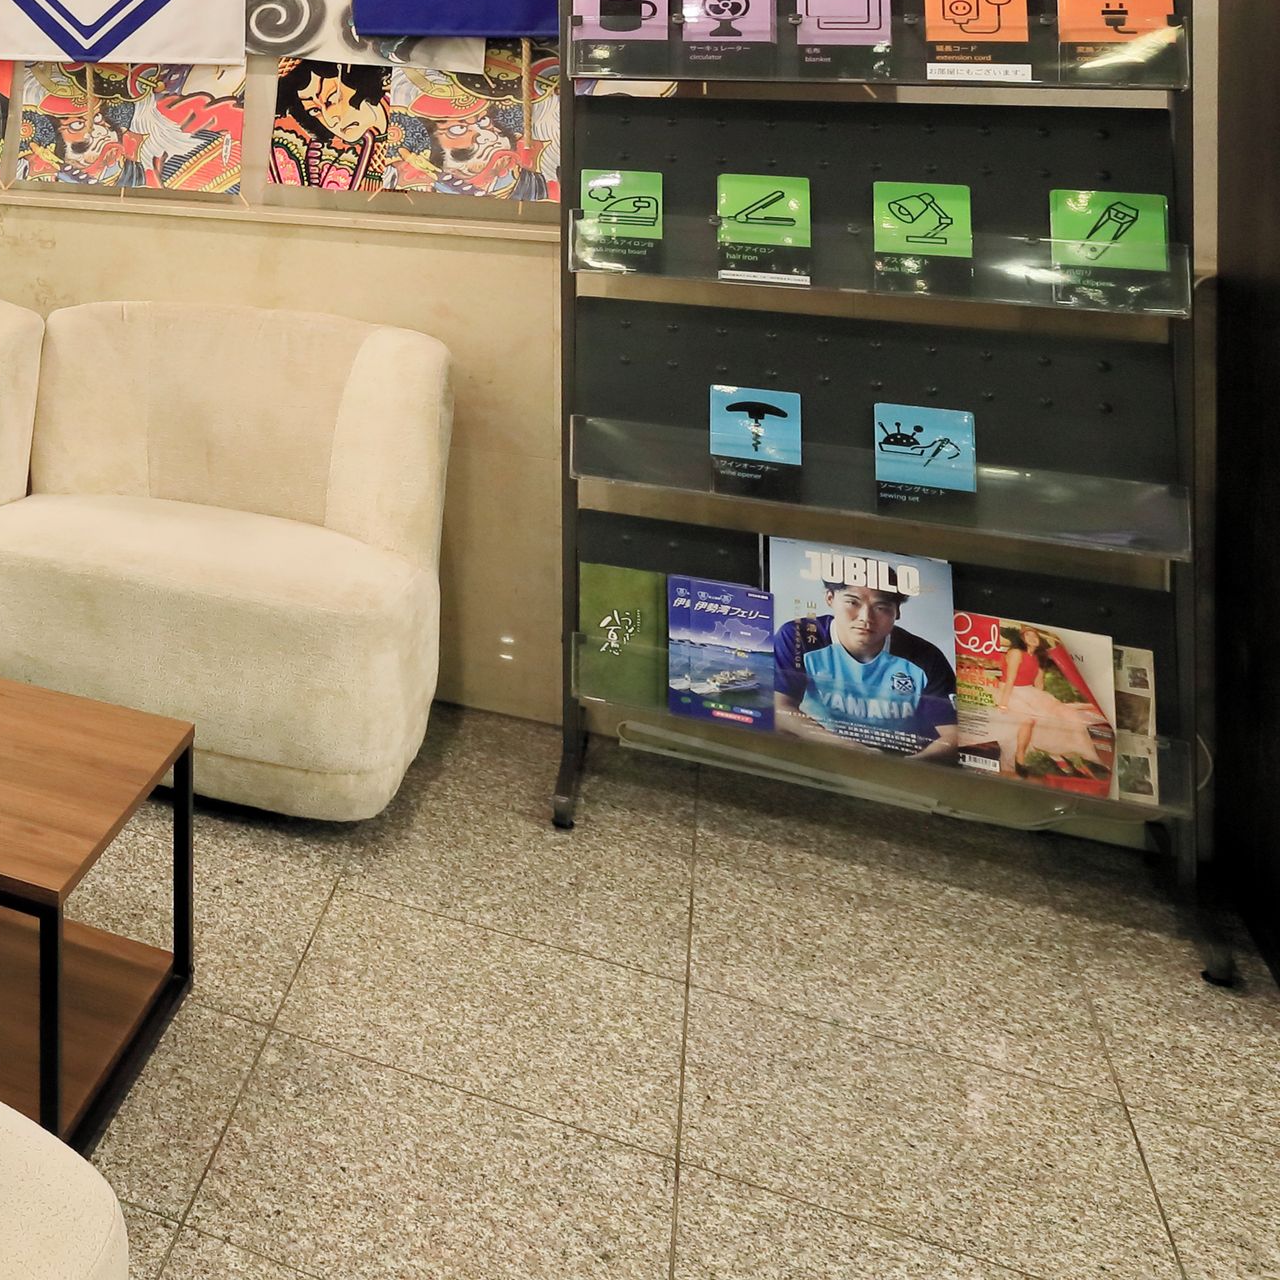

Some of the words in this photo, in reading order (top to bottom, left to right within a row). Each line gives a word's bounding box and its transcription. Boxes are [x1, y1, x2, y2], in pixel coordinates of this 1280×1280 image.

[690, 53, 722, 61] circulator
[726, 253, 743, 261] hair
[743, 253, 759, 261] iron
[720, 469, 737, 477] wine
[738, 471, 761, 480] opener
[879, 482, 946, 496] ソーイングセット
[880, 492, 907, 502] sewing
[908, 494, 920, 502] set
[694, 600, 770, 620] 伊勢湾フェリー
[953, 612, 1009, 655] Red
[820, 691, 915, 719] YAMAHA
